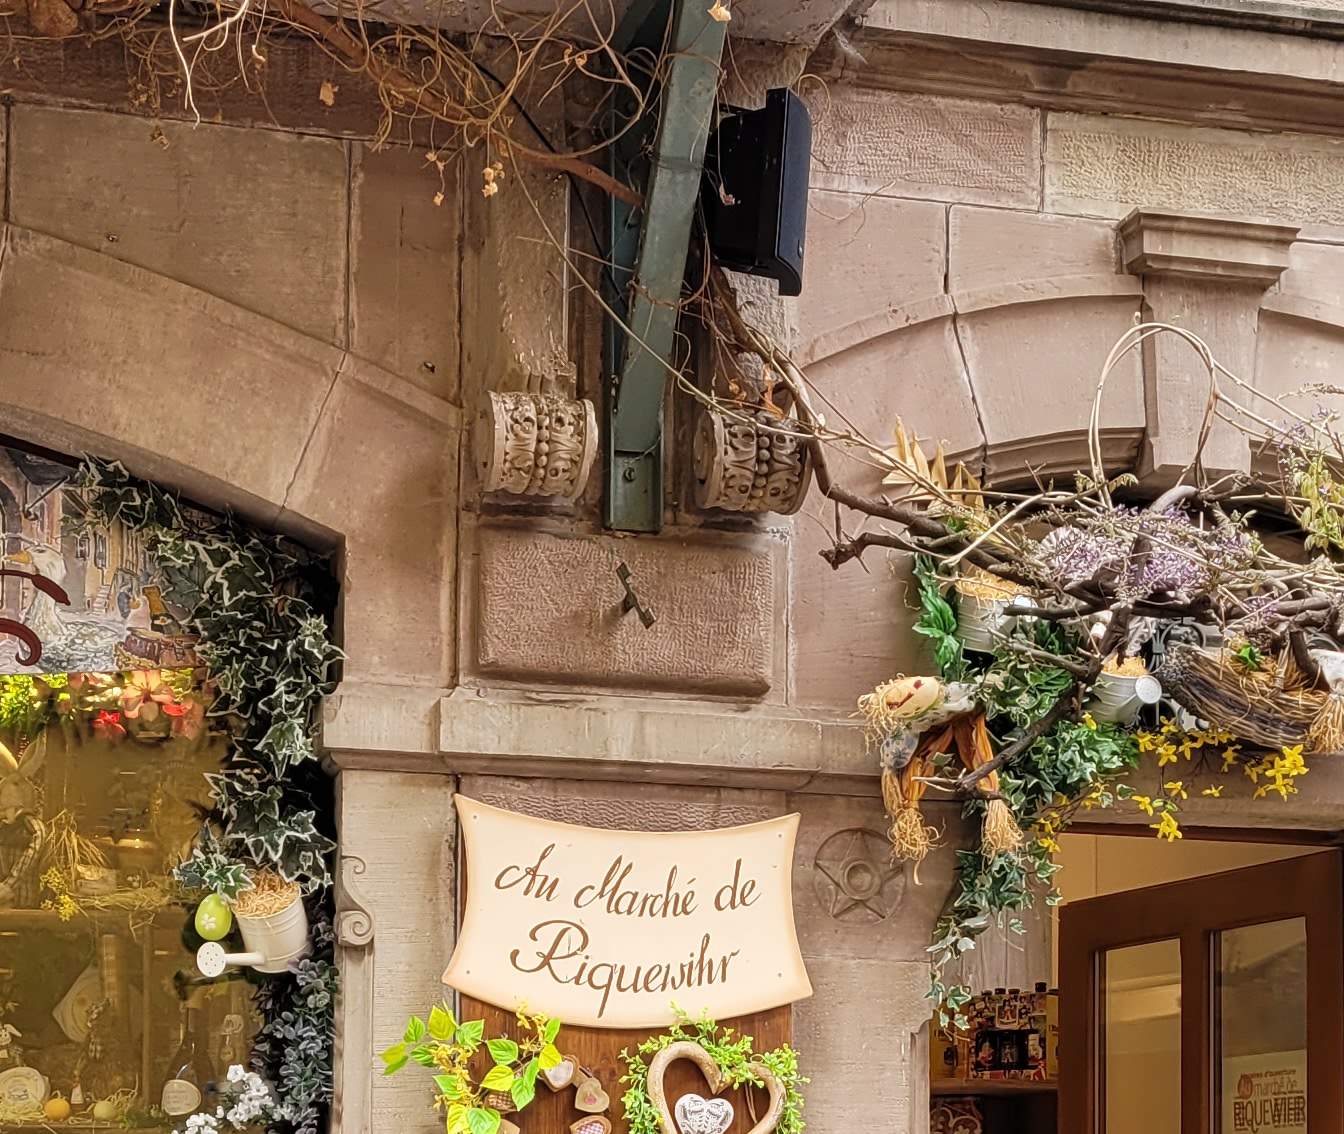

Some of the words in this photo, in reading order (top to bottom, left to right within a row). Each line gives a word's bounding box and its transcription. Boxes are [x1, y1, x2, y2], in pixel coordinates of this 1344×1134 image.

[494, 842, 560, 902] Au
[573, 854, 701, 919] Marché
[714, 857, 764, 913] de
[509, 918, 740, 1019] Riquewihr
